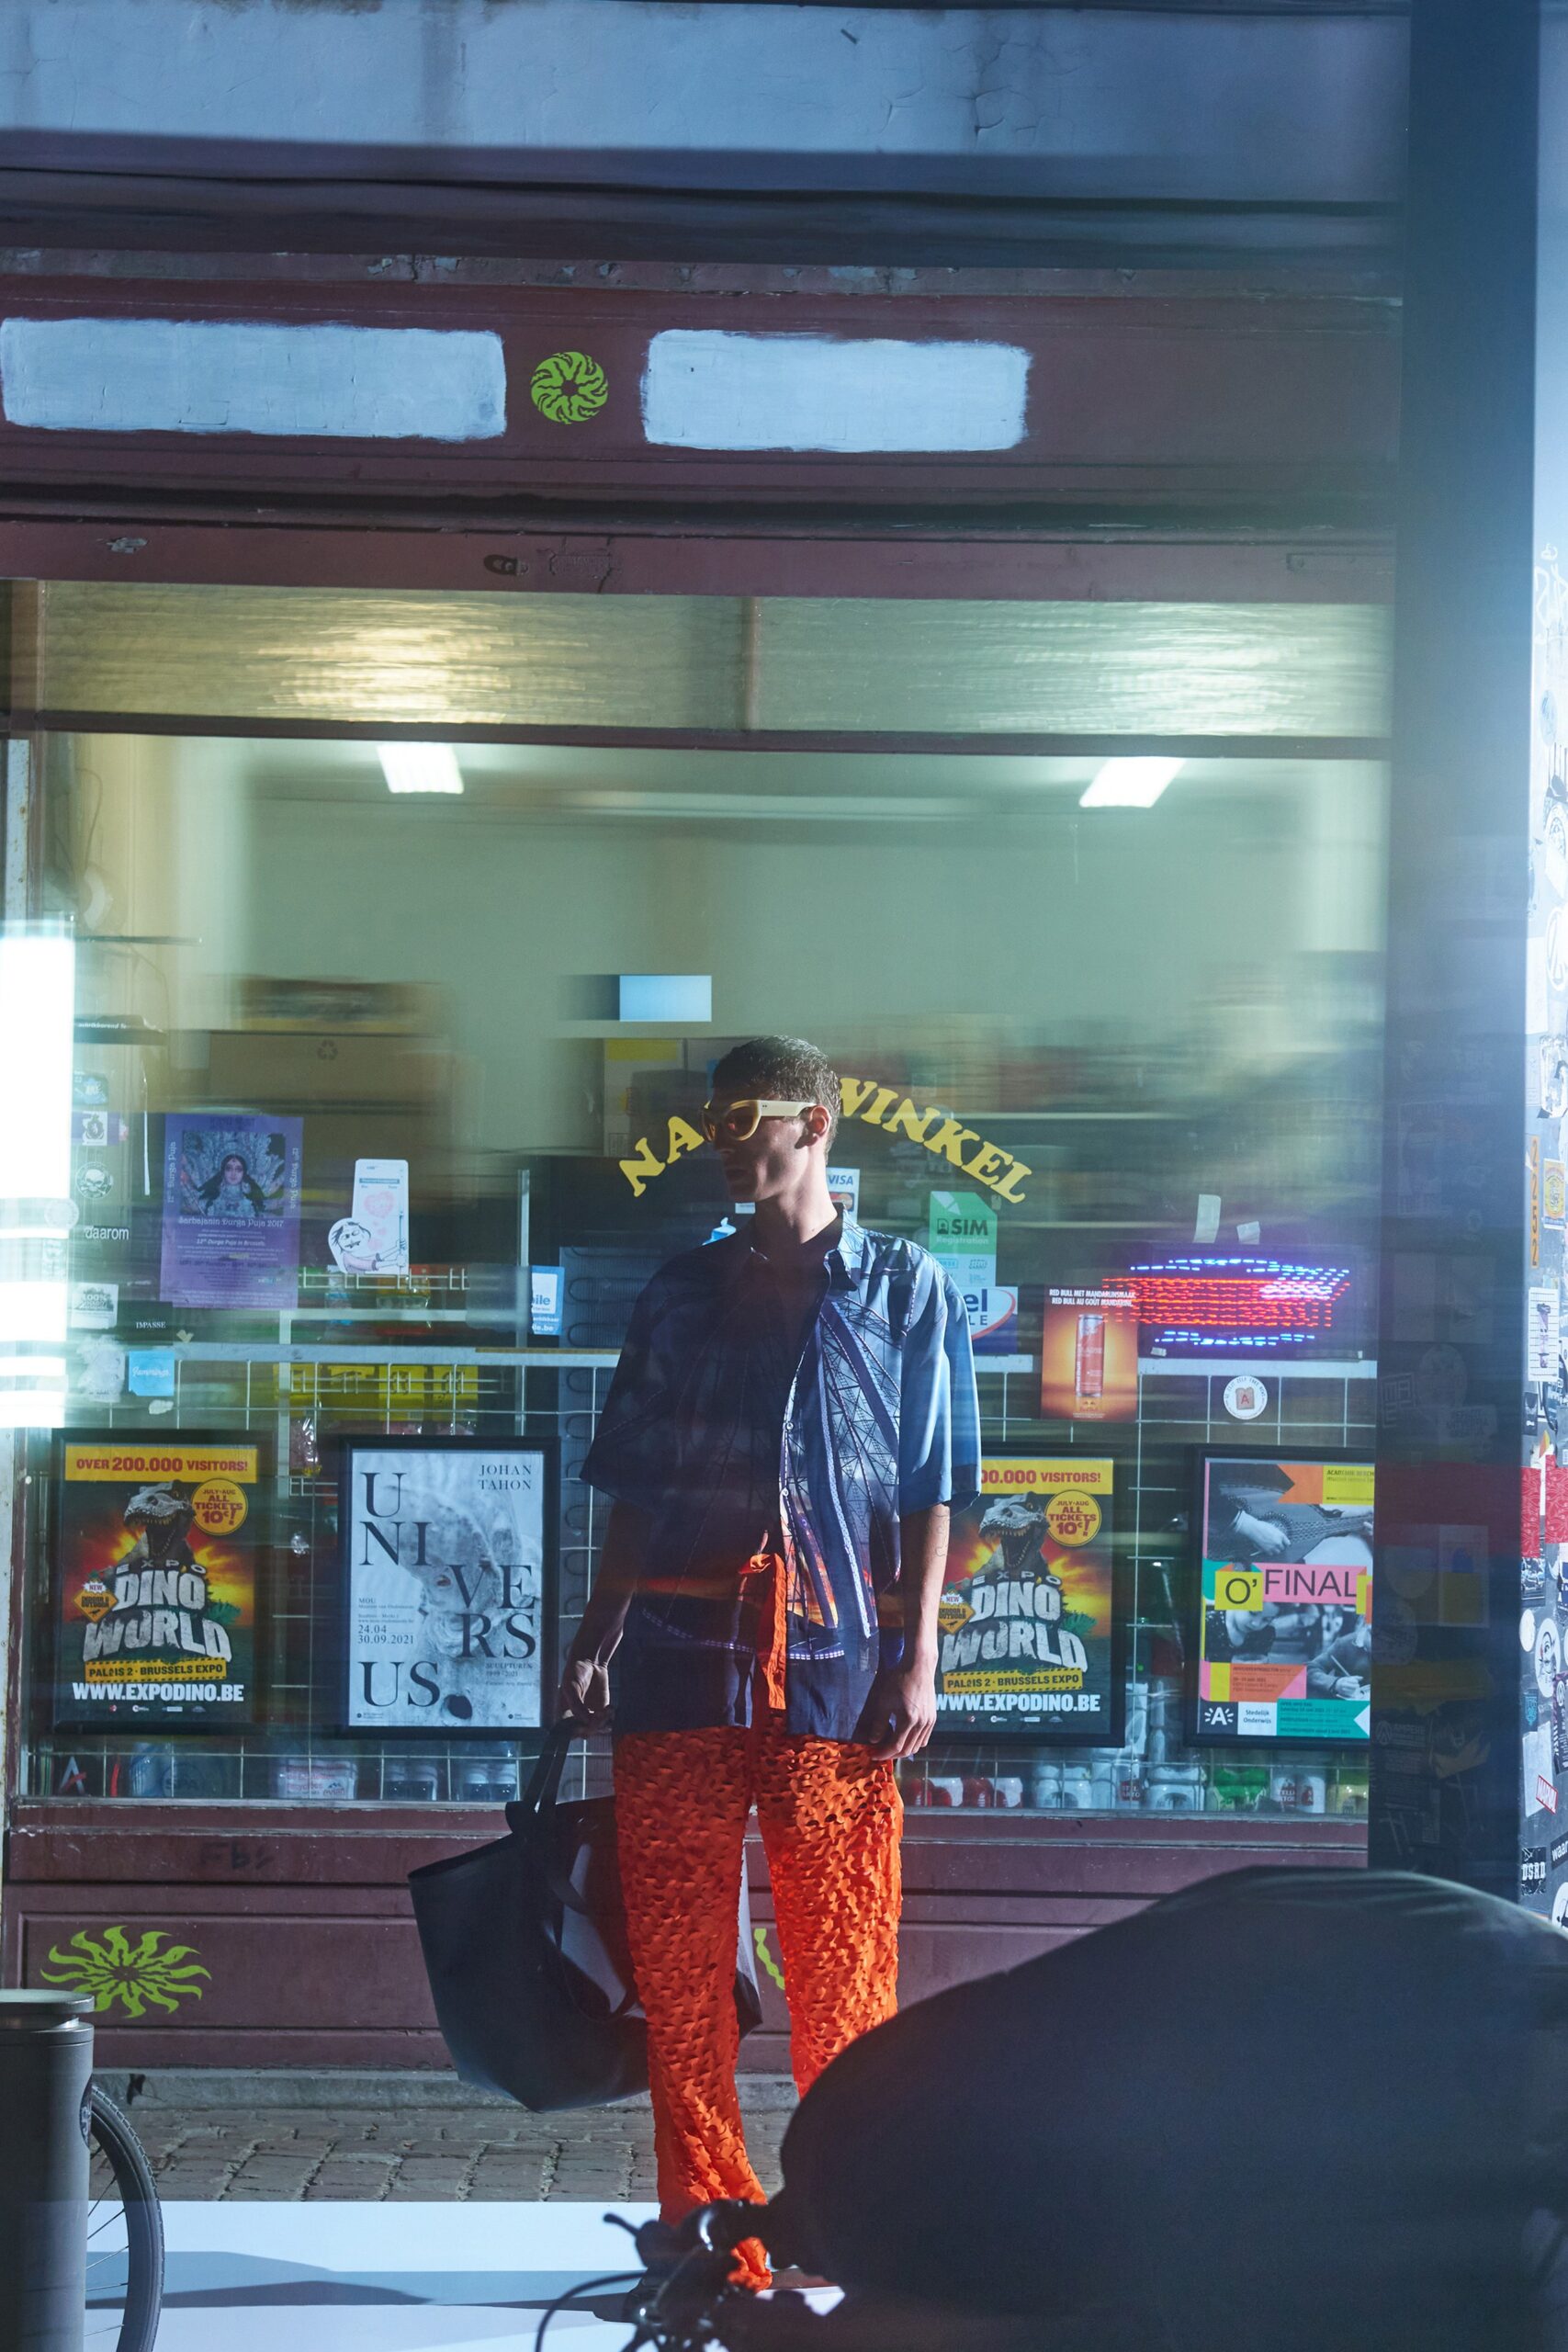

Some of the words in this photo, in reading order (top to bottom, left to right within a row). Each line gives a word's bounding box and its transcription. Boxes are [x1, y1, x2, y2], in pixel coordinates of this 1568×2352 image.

[828, 1175, 853, 1185] VISA
[247, 1218, 265, 1228] Puja
[951, 1218, 988, 1236] SIM
[85, 1226, 130, 1240] daarom
[936, 1236, 989, 1245] Registration
[136, 1321, 166, 1329] IMPASSE
[76, 1458, 109, 1470] OVER
[112, 1456, 183, 1472] 200.000
[186, 1460, 248, 1471] VISITORS!
[479, 1464, 532, 1476] JOHAN
[478, 1479, 531, 1490] TAHON
[981, 1469, 1036, 1485] 00.000
[1040, 1472, 1101, 1484] VISITORS!
[360, 1472, 407, 1518] U
[195, 1502, 243, 1510] TICKETS
[358, 1521, 433, 1566] NI
[112, 1569, 207, 1611] DINO
[446, 1565, 536, 1609] VE
[1265, 1568, 1357, 1598] FINAL
[969, 1580, 1061, 1623] DINO
[83, 1609, 232, 1663] WORLD
[357, 1624, 387, 1634] 24.04
[456, 1612, 536, 1659] RS
[357, 1634, 414, 1645] 30.09.2021
[942, 1620, 1089, 1674] WORLD
[127, 1667, 133, 1676] 2
[141, 1665, 193, 1676] BRUSSELS
[196, 1664, 223, 1674] EXPO
[357, 1660, 441, 1707] US
[985, 1678, 991, 1686] 2
[998, 1675, 1050, 1686] BRUSSELS
[1052, 1674, 1078, 1684] EXPO
[73, 1682, 244, 1702] WWW.EXPODINO.BE
[936, 1693, 1100, 1712] WWW.EXPODINO.BE
[1243, 1717, 1271, 1725] Onderwijs
[1246, 1709, 1269, 1717] Stedelijk
